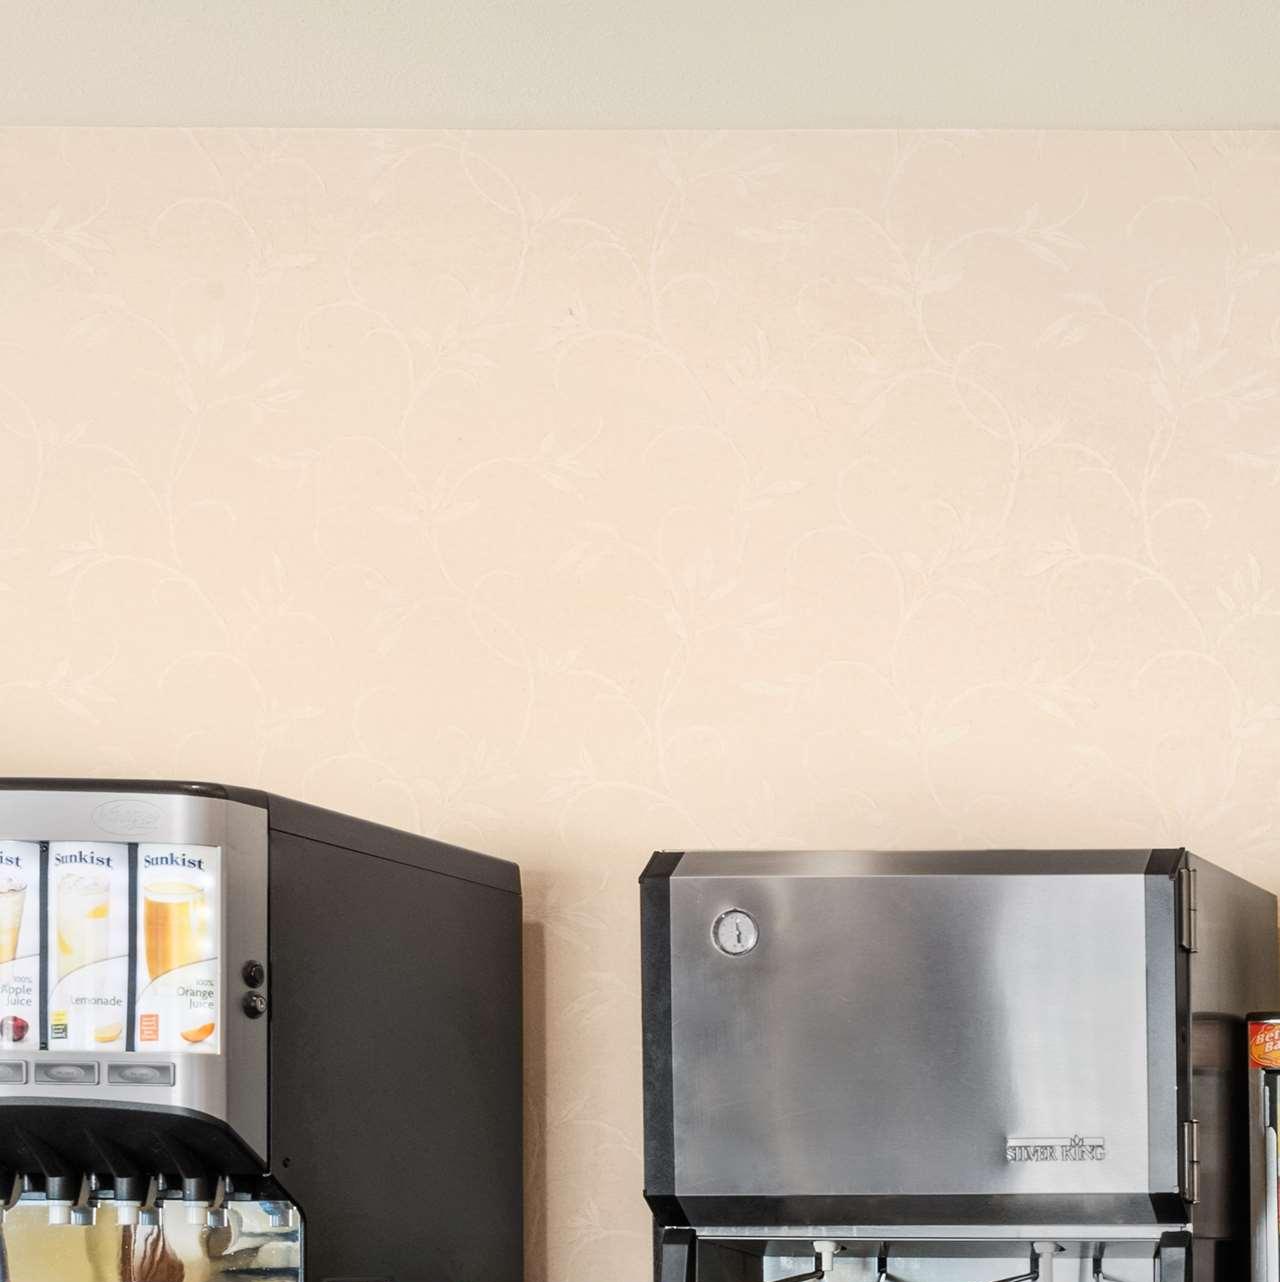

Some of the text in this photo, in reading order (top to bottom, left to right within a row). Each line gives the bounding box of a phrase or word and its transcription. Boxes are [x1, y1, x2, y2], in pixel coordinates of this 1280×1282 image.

[55, 851, 113, 869] Sunkist
[144, 853, 205, 871] Sunkist
[177, 986, 214, 1000] Orange
[1006, 1144, 1105, 1161] SILVER KING
